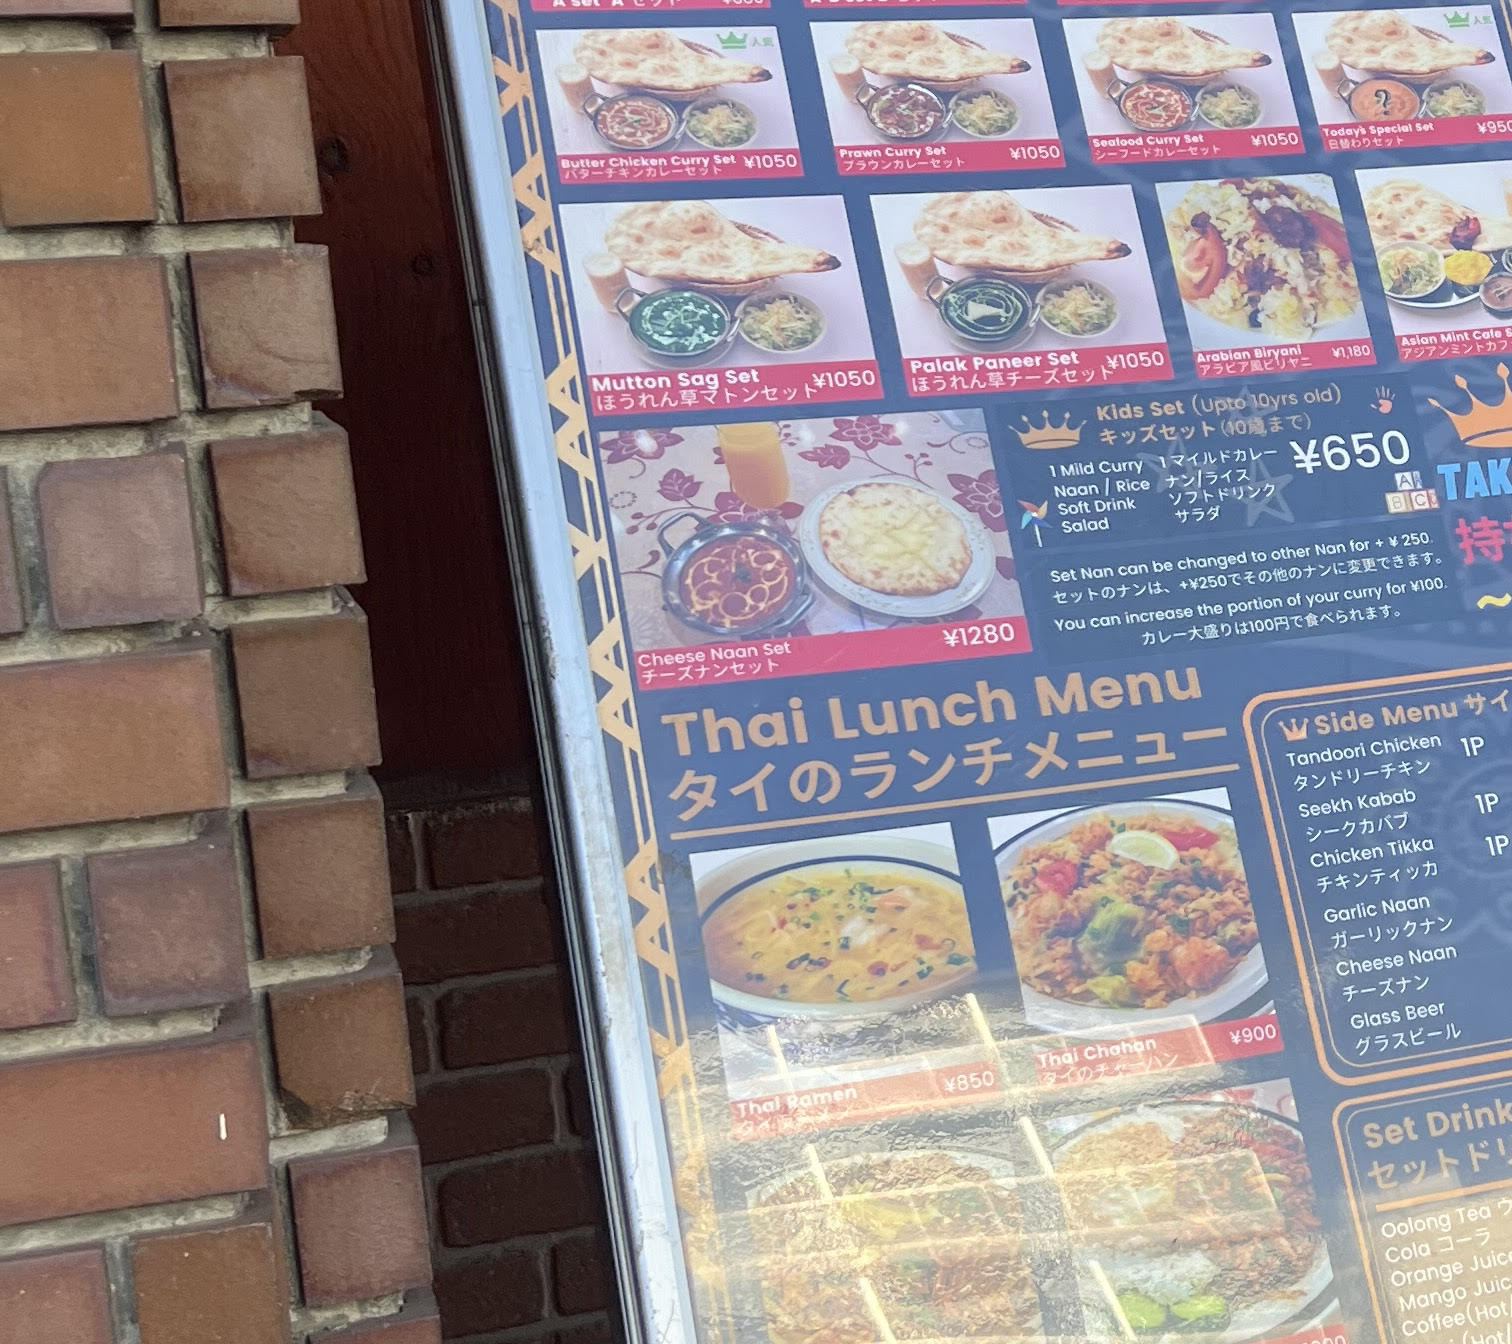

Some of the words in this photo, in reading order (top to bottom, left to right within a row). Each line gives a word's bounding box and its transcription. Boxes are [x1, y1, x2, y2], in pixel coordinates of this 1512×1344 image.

[1329, 135, 1404, 149] 日替わりセット
[562, 157, 604, 169] Butter
[608, 157, 667, 168] Chicken
[671, 156, 708, 169] Curry
[712, 154, 736, 165] Set
[744, 154, 797, 169] ¥1050
[910, 358, 968, 373] Palak
[973, 354, 1042, 371] Paneer
[1047, 351, 1079, 365] Set
[1107, 352, 1164, 370] ¥1050
[592, 372, 670, 393] Mutton
[680, 371, 720, 390] Sag
[725, 368, 759, 385] Set
[813, 369, 875, 388] ¥1050
[597, 382, 815, 410] ほうれん草マトンセット
[1096, 404, 1144, 420] Kids
[1150, 400, 1184, 416] Set
[1100, 421, 1215, 445] キッズセット
[1289, 430, 1411, 475] ¥650
[1058, 501, 1090, 515] Soft
[1096, 496, 1136, 511] Drink
[1170, 483, 1275, 505] ソフトドリンク
[1062, 517, 1109, 533] Salad
[1174, 506, 1221, 523] サラダ
[638, 651, 705, 668] Cheese
[710, 644, 758, 660] Naan
[763, 641, 791, 655] Set
[943, 624, 1015, 647] ¥1280
[642, 657, 780, 683] チーズナンセット
[661, 698, 808, 758] Thai
[830, 677, 1016, 740] Lunch
[1036, 666, 1202, 718] Menu
[1313, 715, 1374, 736] Side
[1382, 703, 1458, 726] Menu
[1286, 743, 1366, 766] Tandoori
[1370, 734, 1442, 754] Chicken
[1460, 736, 1486, 757] 1P
[668, 727, 1228, 822] タイのランチメニュー
[1293, 760, 1431, 791] タンドリーチキン
[1324, 903, 1377, 923] Garlic
[1381, 895, 1430, 916] Naan
[1332, 916, 1454, 949] ガーリックナン
[1350, 1009, 1401, 1029] Glass
[1405, 1002, 1445, 1021] Beer
[1355, 1023, 1461, 1055] グラスビール
[1363, 1116, 1417, 1148] Set
[1381, 1213, 1452, 1239] Oolong
[1456, 1204, 1491, 1224] Tea
[1385, 1241, 1431, 1263] Cola
[1439, 1228, 1490, 1253] コーラ
